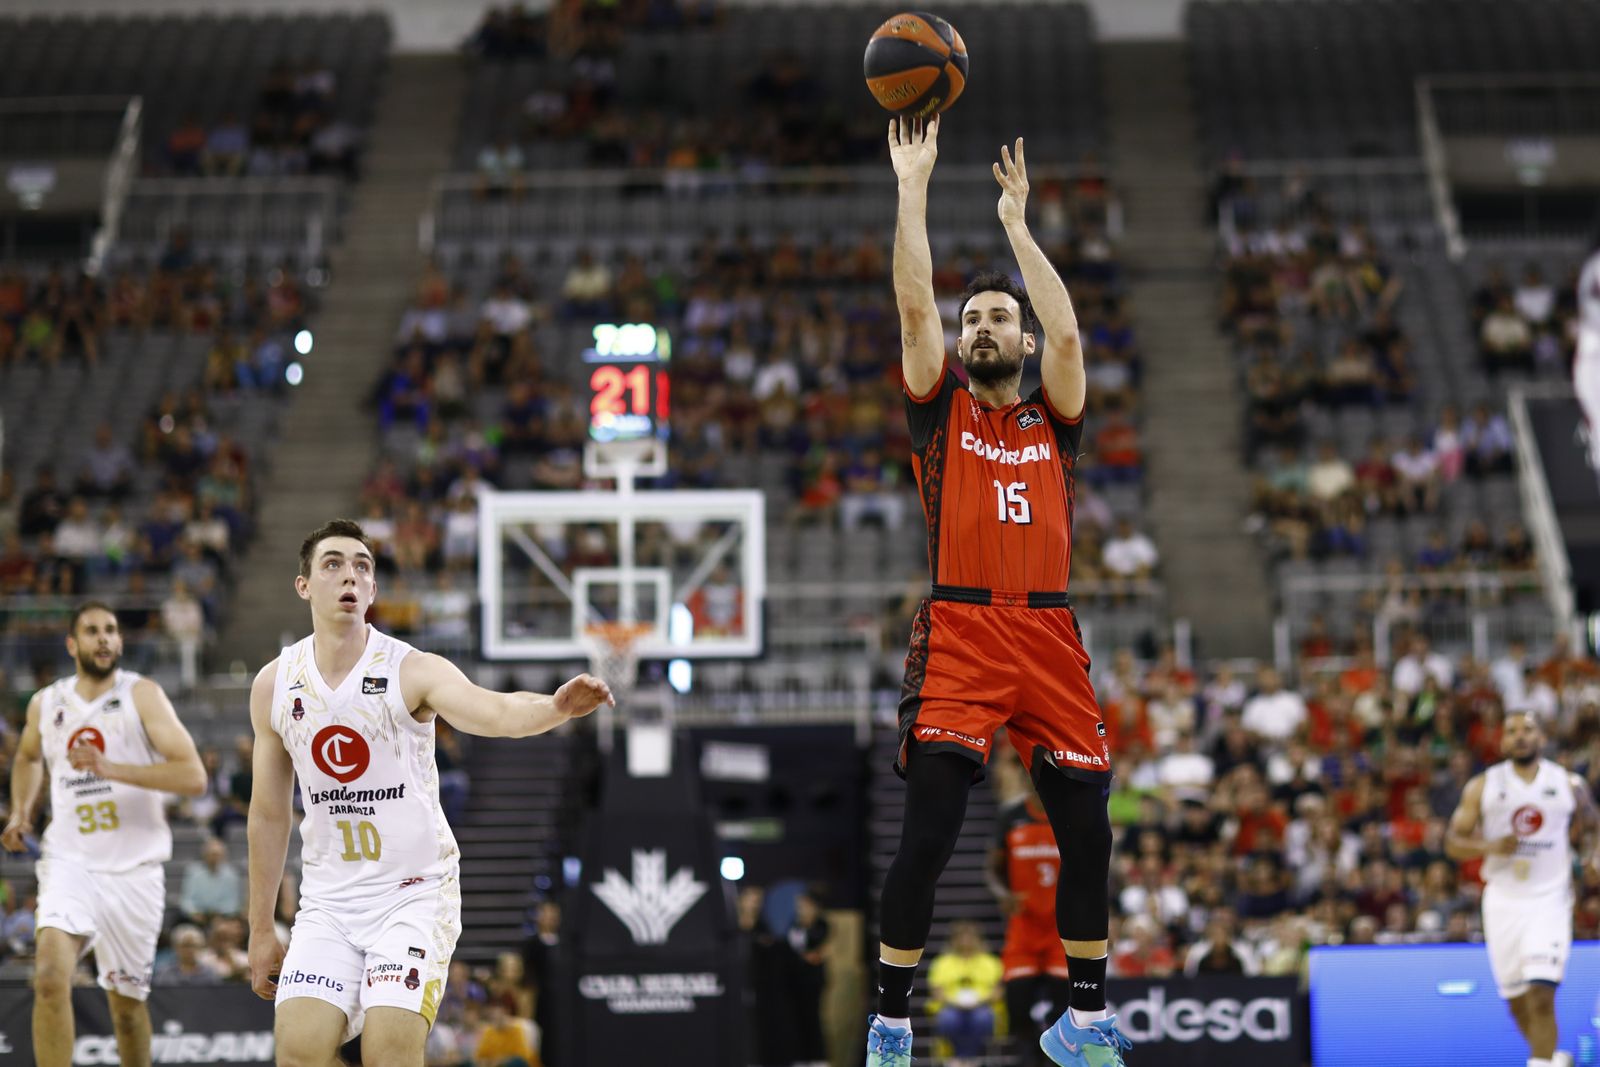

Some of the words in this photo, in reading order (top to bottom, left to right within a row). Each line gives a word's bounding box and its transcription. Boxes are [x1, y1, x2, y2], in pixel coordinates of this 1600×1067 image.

[590, 365, 650, 417] 21
[993, 479, 1032, 524] 15
[75, 801, 120, 835] 33
[336, 820, 382, 861] 10
[281, 970, 344, 992] hiberus
